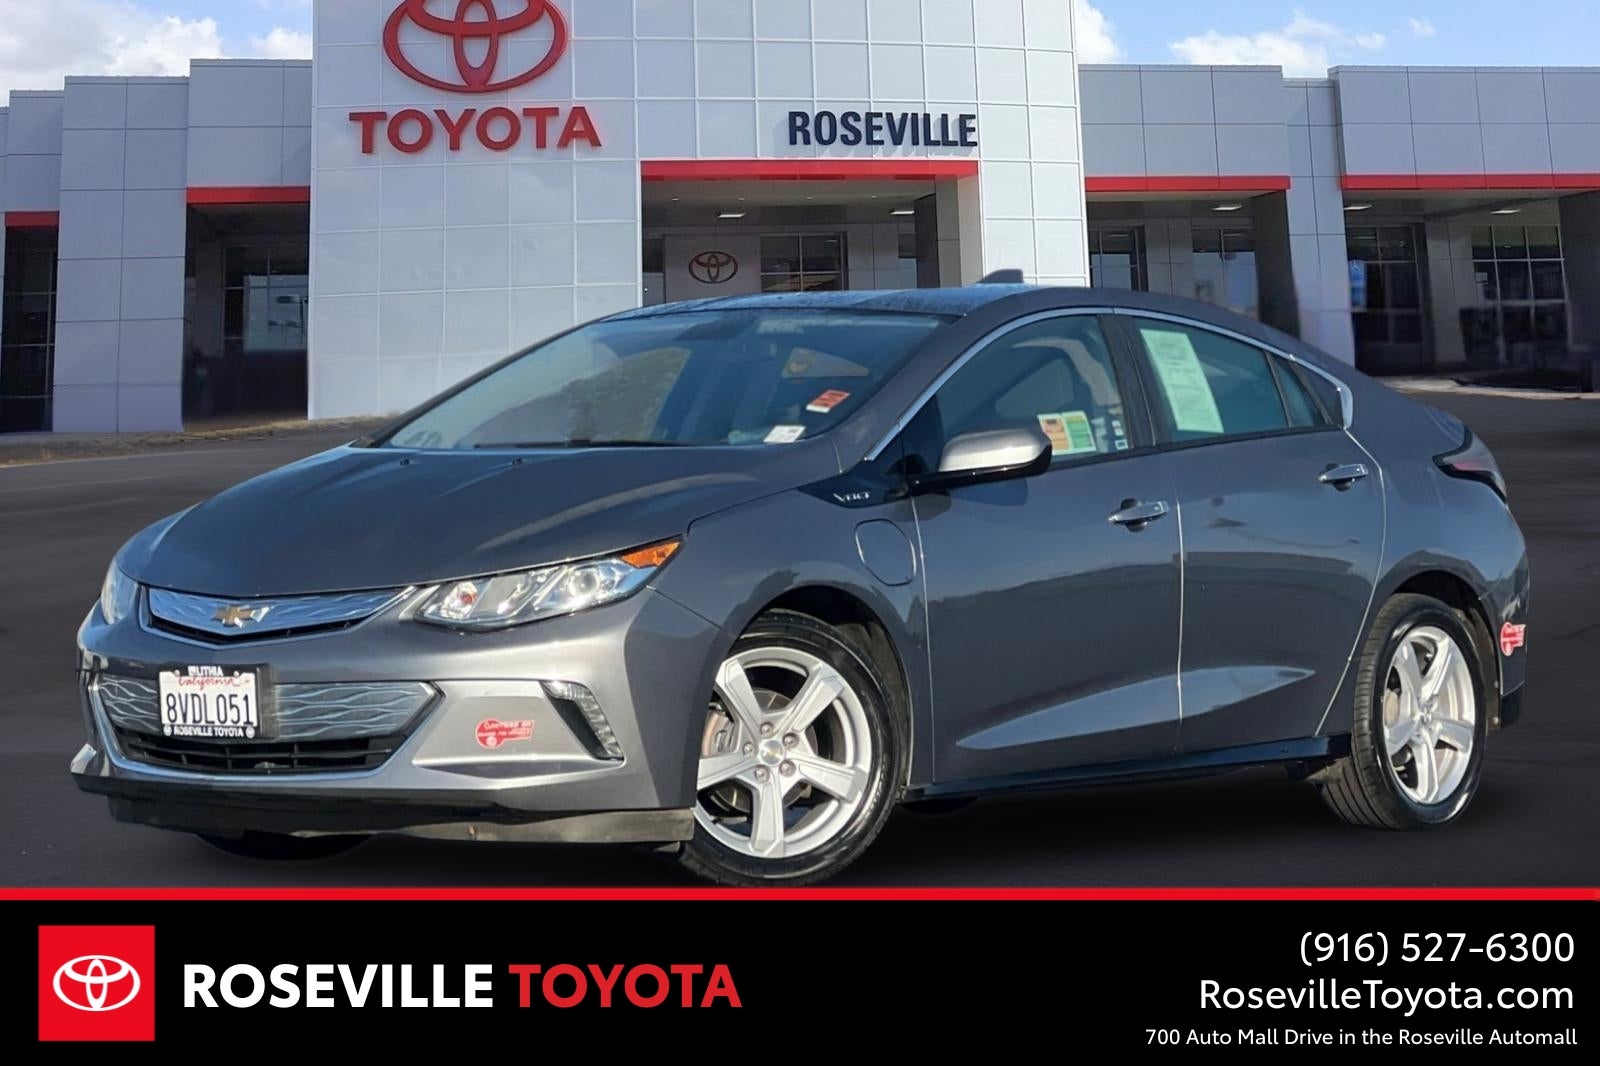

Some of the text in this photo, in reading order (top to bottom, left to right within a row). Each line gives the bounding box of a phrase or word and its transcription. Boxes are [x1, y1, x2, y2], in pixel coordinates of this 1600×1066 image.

[349, 105, 602, 154] TOYOTA
[789, 111, 978, 147] ROSEVILLE
[166, 693, 254, 726] 8VDL051
[173, 726, 244, 738] ROSEVILLE TOYOTA
